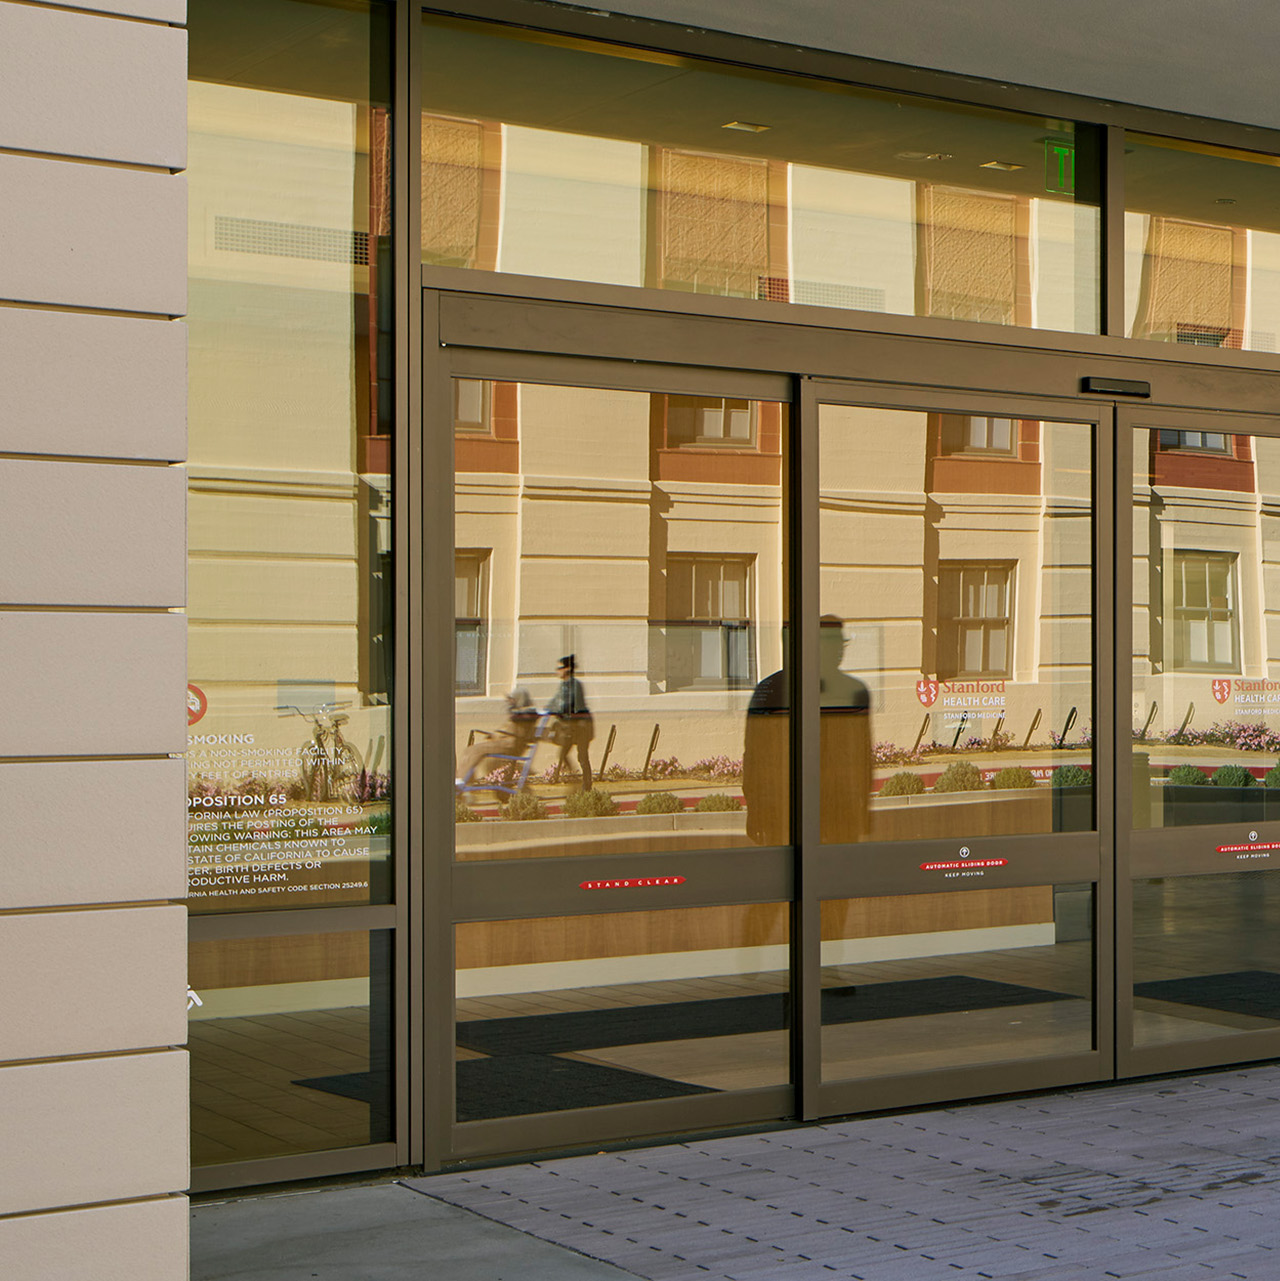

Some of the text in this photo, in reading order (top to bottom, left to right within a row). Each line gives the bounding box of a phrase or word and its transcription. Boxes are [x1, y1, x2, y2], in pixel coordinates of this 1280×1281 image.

[943, 679, 1005, 694] Stanford
[943, 697, 1005, 706] HEALTH CARE
[1234, 694, 1265, 703] HEALTH
[198, 750, 207, 758] A
[210, 748, 293, 759] NON-SMOKING
[214, 760, 237, 769] NOT
[241, 758, 303, 768] PERMITTED
[306, 758, 346, 767] WITHIN
[201, 771, 229, 780] FEET
[232, 770, 249, 779] OF
[252, 769, 298, 778] ENTRIES
[269, 794, 287, 805] 65
[235, 810, 261, 819] LAW
[263, 807, 343, 818] (PROPOSITION
[346, 806, 364, 815] 65)
[222, 821, 243, 830] THE
[247, 820, 297, 829] POSTING
[298, 819, 314, 827] OF
[317, 817, 339, 826] THE
[234, 830, 292, 841] WARNING:
[294, 828, 319, 838] THIS
[322, 827, 352, 836] AREA
[355, 826, 378, 835] MAY
[216, 842, 281, 853] CHEMICALS
[284, 839, 328, 849] KNOWN
[331, 838, 346, 847] TO
[225, 854, 241, 863] OF
[245, 851, 313, 862] CALIFORNIA
[315, 849, 331, 858] TO
[333, 847, 370, 857] CAUSE
[215, 864, 249, 874] BIRTH
[252, 862, 302, 872] DEFECTS
[305, 860, 322, 869] OR
[253, 873, 289, 883] HARM.
[588, 878, 678, 889] STAND CLEAR
[209, 889, 239, 897] HEALTH
[258, 886, 286, 894] SAFETY
[309, 883, 341, 891] SECTION
[342, 881, 368, 889] 25249.6
